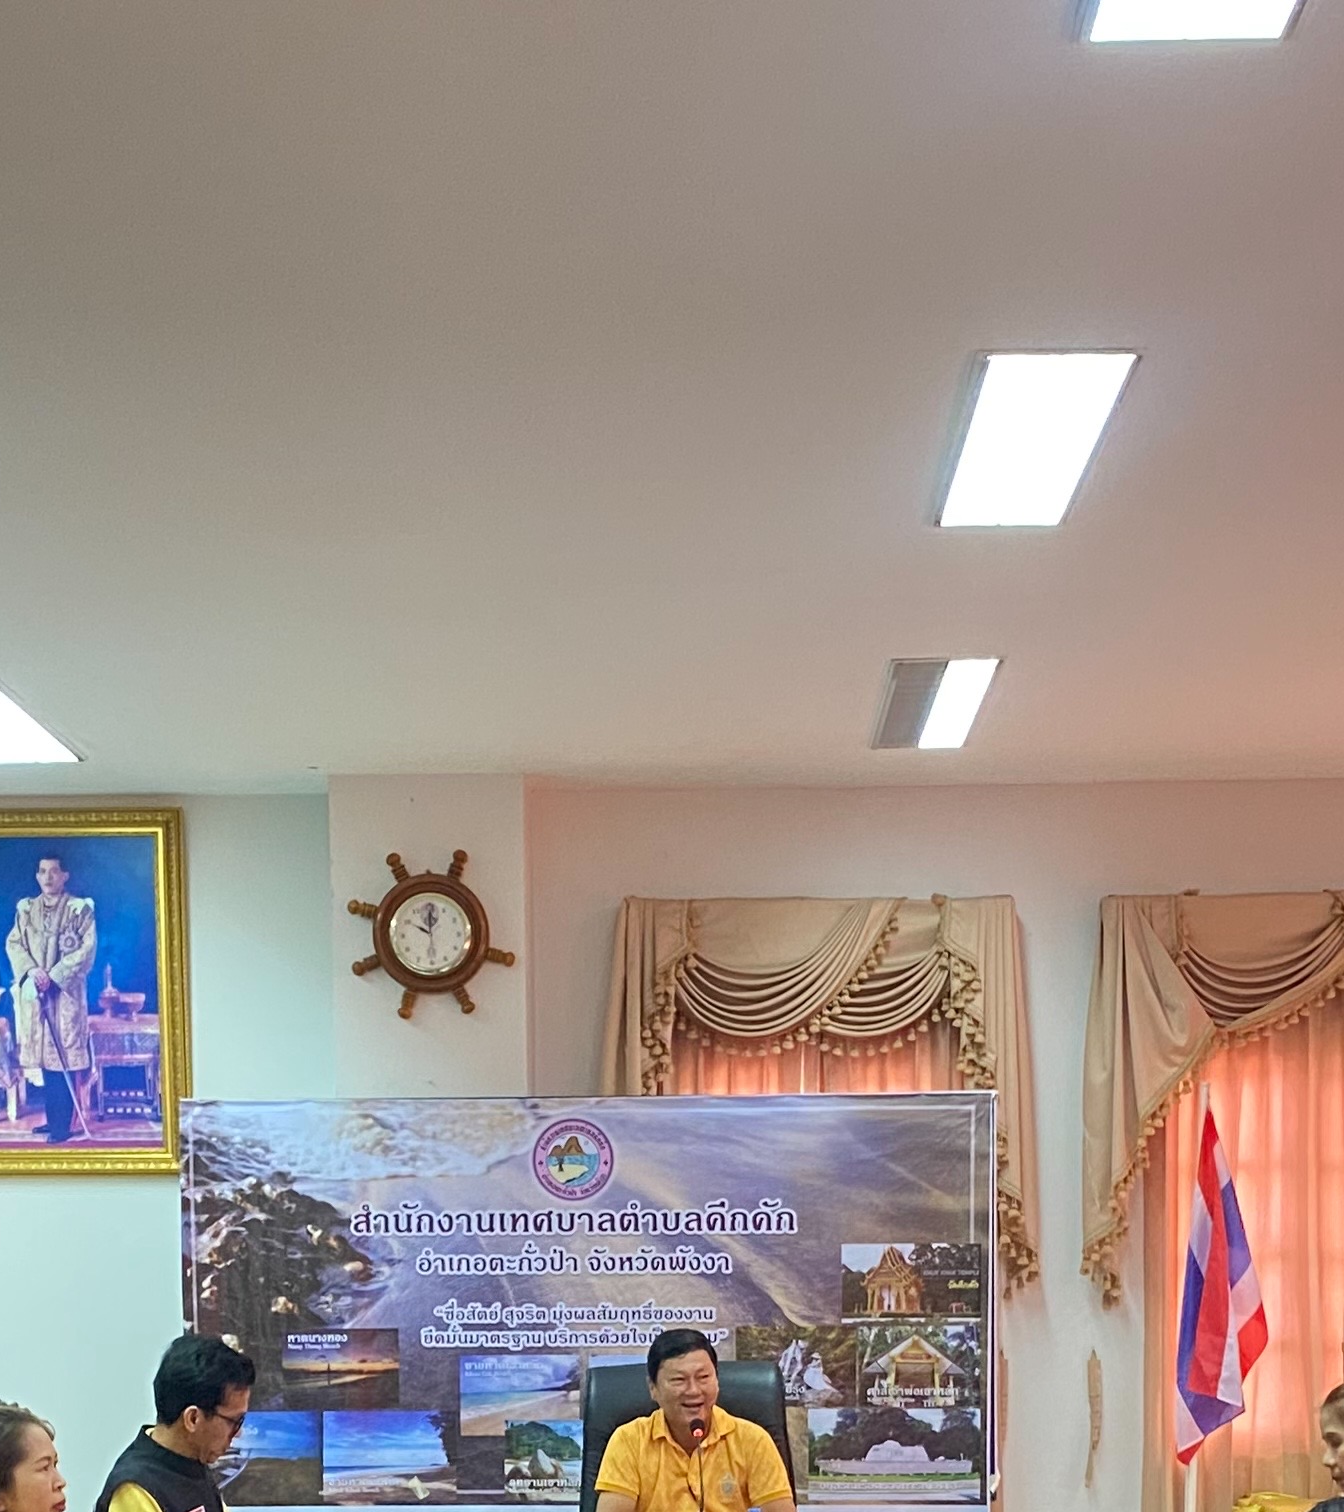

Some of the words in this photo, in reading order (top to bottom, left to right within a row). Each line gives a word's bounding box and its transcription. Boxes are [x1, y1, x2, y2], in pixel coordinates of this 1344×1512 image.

[351, 1201, 796, 1233] สำนักงานเทศบาลตำบลคึกคัก
[417, 1244, 579, 1273] อำเภอตะกั่วป่า
[587, 1248, 731, 1273] จังหวัดพังงา
[504, 1306, 547, 1326] สุจริต
[552, 1302, 714, 1325] มุ่งผลสัมฤทธิ์ของงาน
[423, 1324, 542, 1347] ยึดมั่นมาตรฐาน
